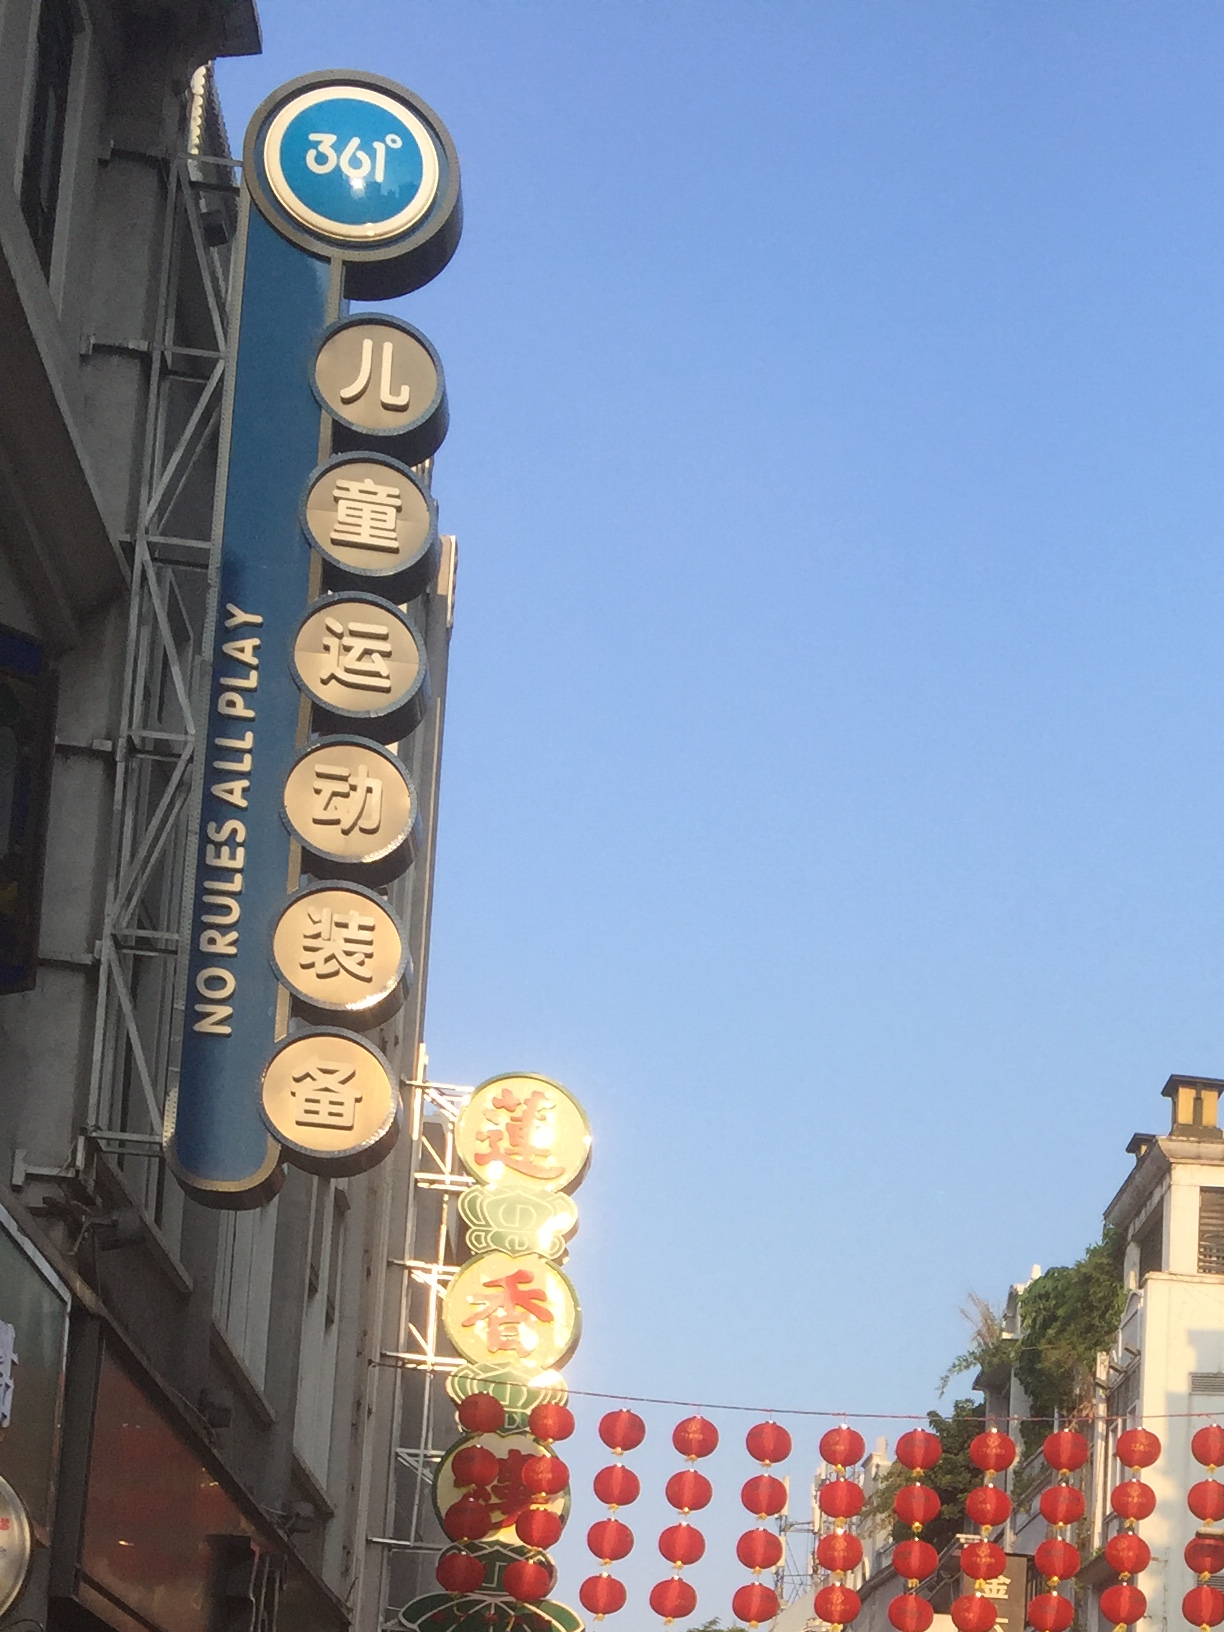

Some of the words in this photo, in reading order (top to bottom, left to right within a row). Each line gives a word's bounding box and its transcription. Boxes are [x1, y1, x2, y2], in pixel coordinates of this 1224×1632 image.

[217, 602, 264, 720] PLAY
[210, 730, 252, 809] ALL
[291, 338, 411, 1131] 儿童运动装备
[199, 818, 248, 956] RULES
[192, 966, 237, 1036] NO
